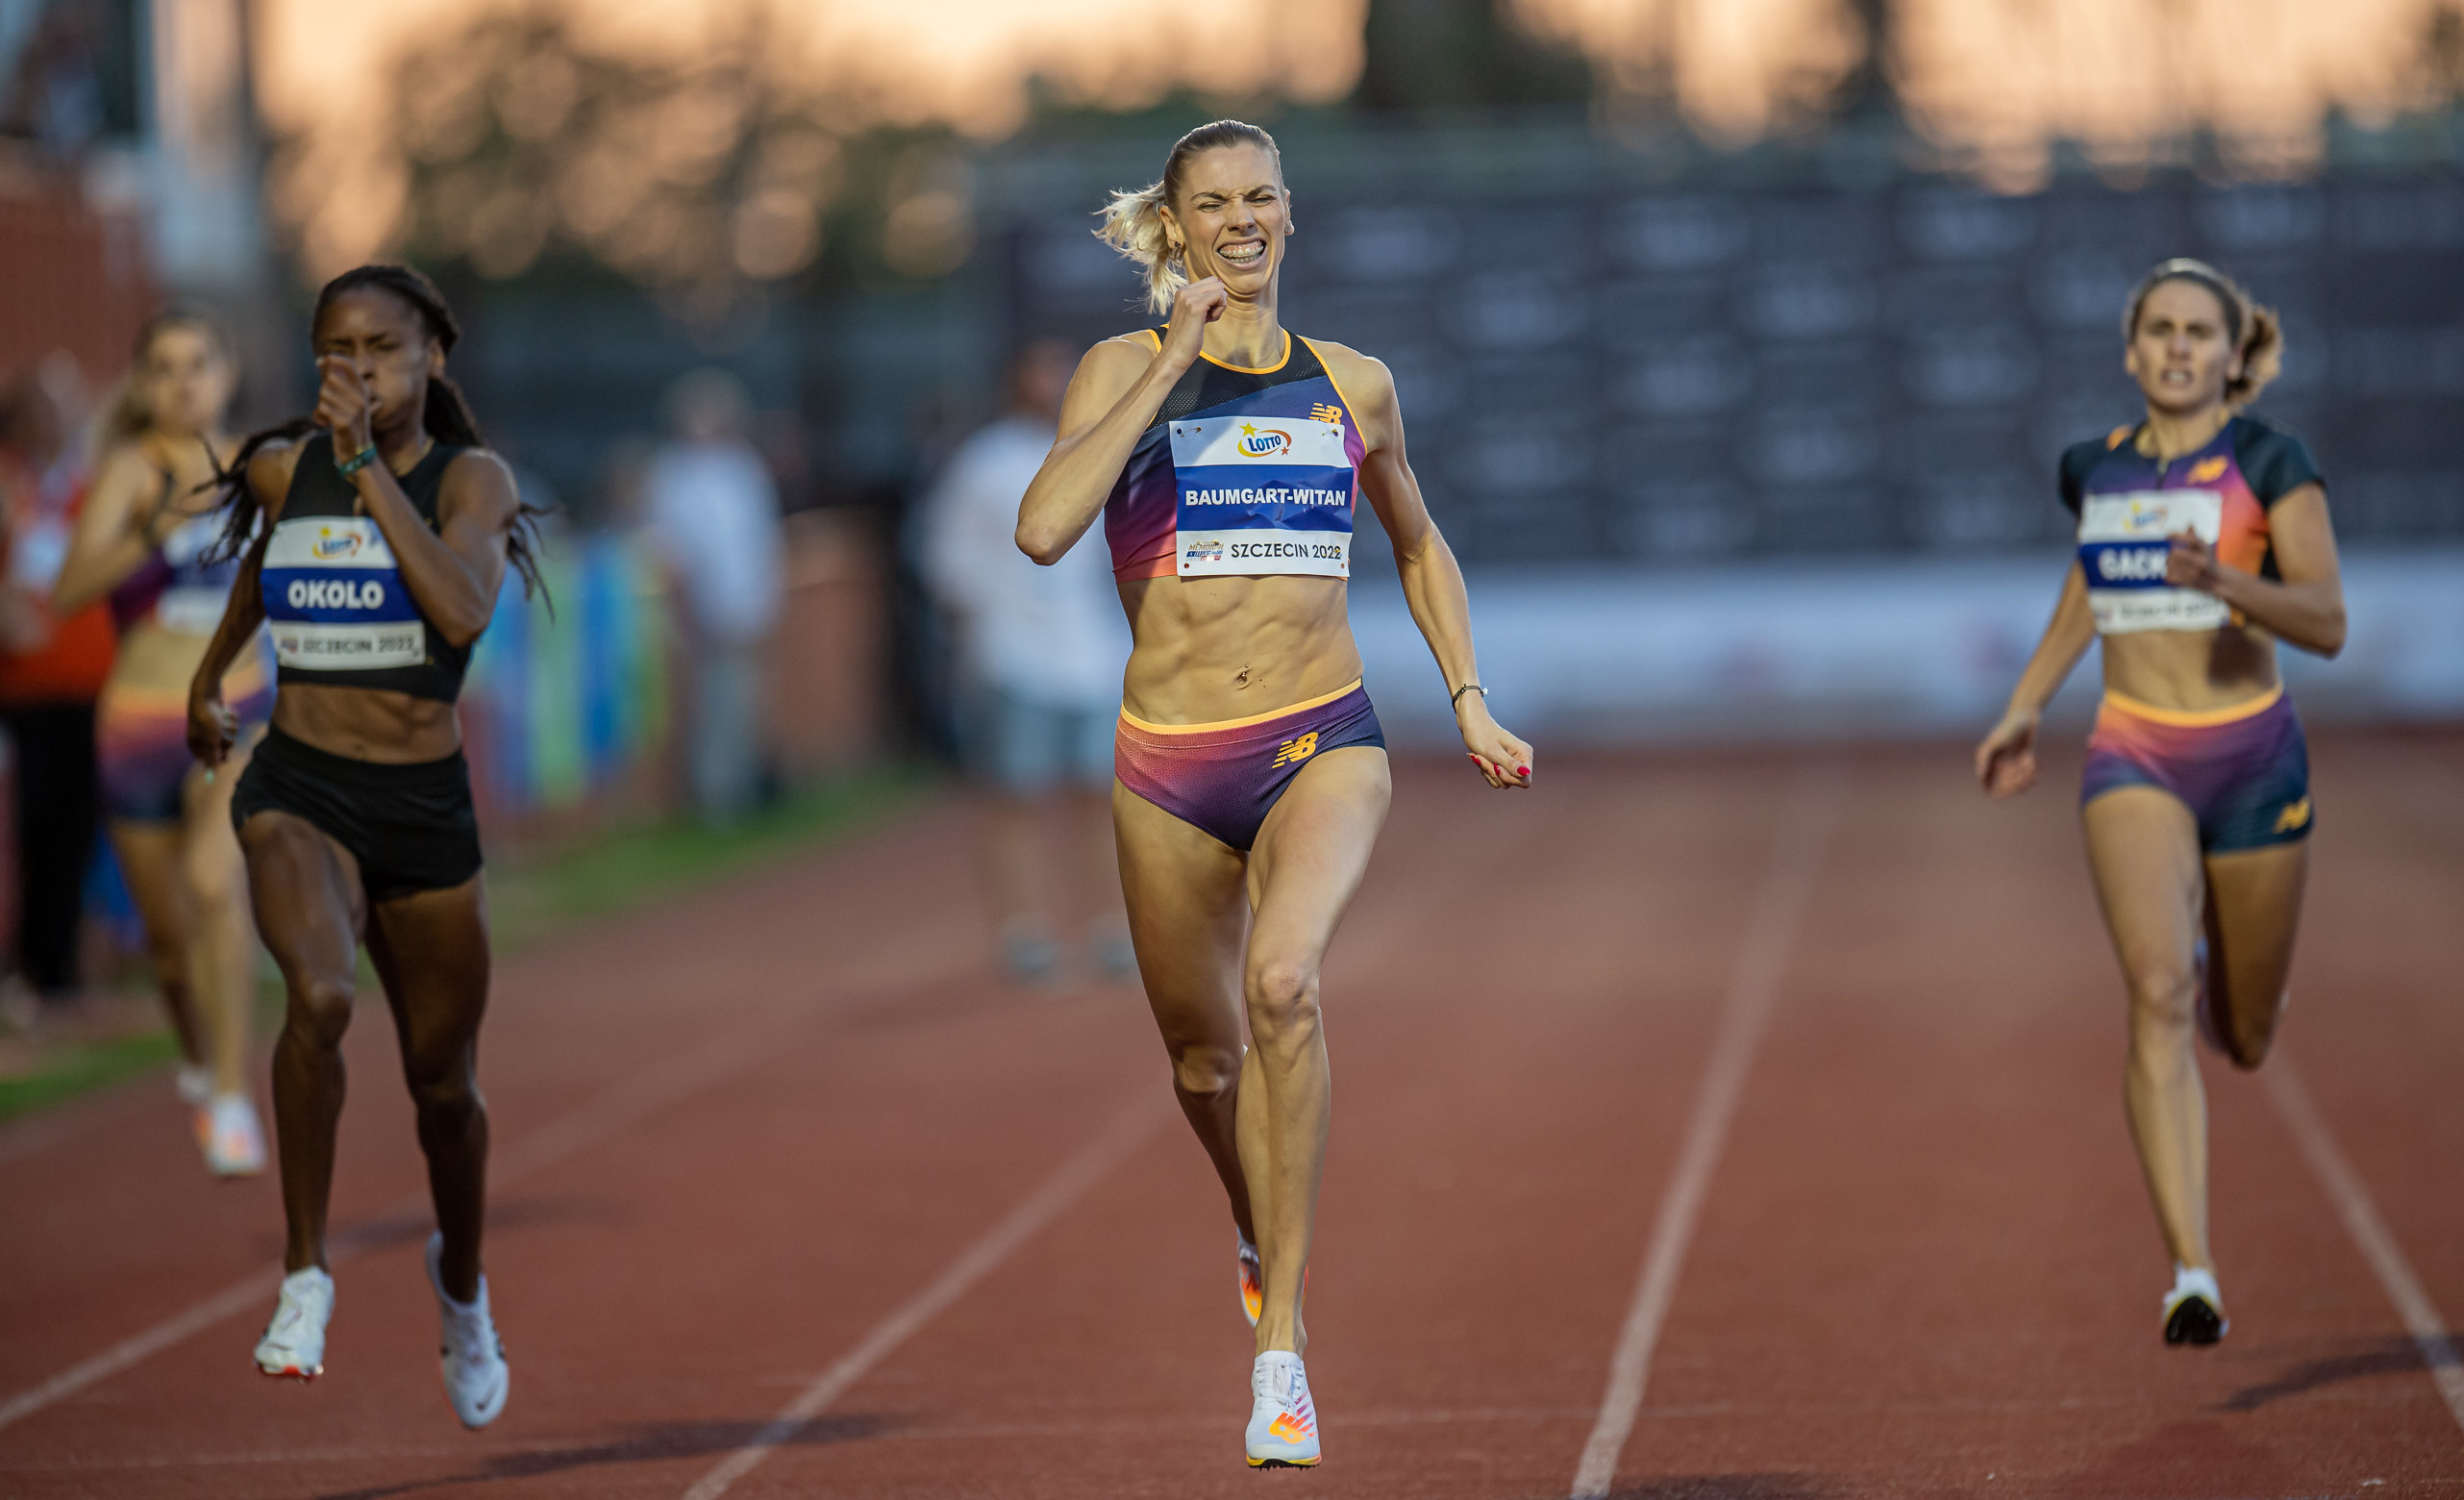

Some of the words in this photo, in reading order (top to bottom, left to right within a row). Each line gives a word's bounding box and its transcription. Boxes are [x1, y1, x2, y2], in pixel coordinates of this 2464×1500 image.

[1248, 435, 1282, 453] LOTTO
[1185, 488, 1346, 506] BAUMGART-WITAN
[1231, 543, 1308, 559] SZCZECIN
[1312, 544, 1341, 560] 2022
[287, 579, 385, 610] OKOLO
